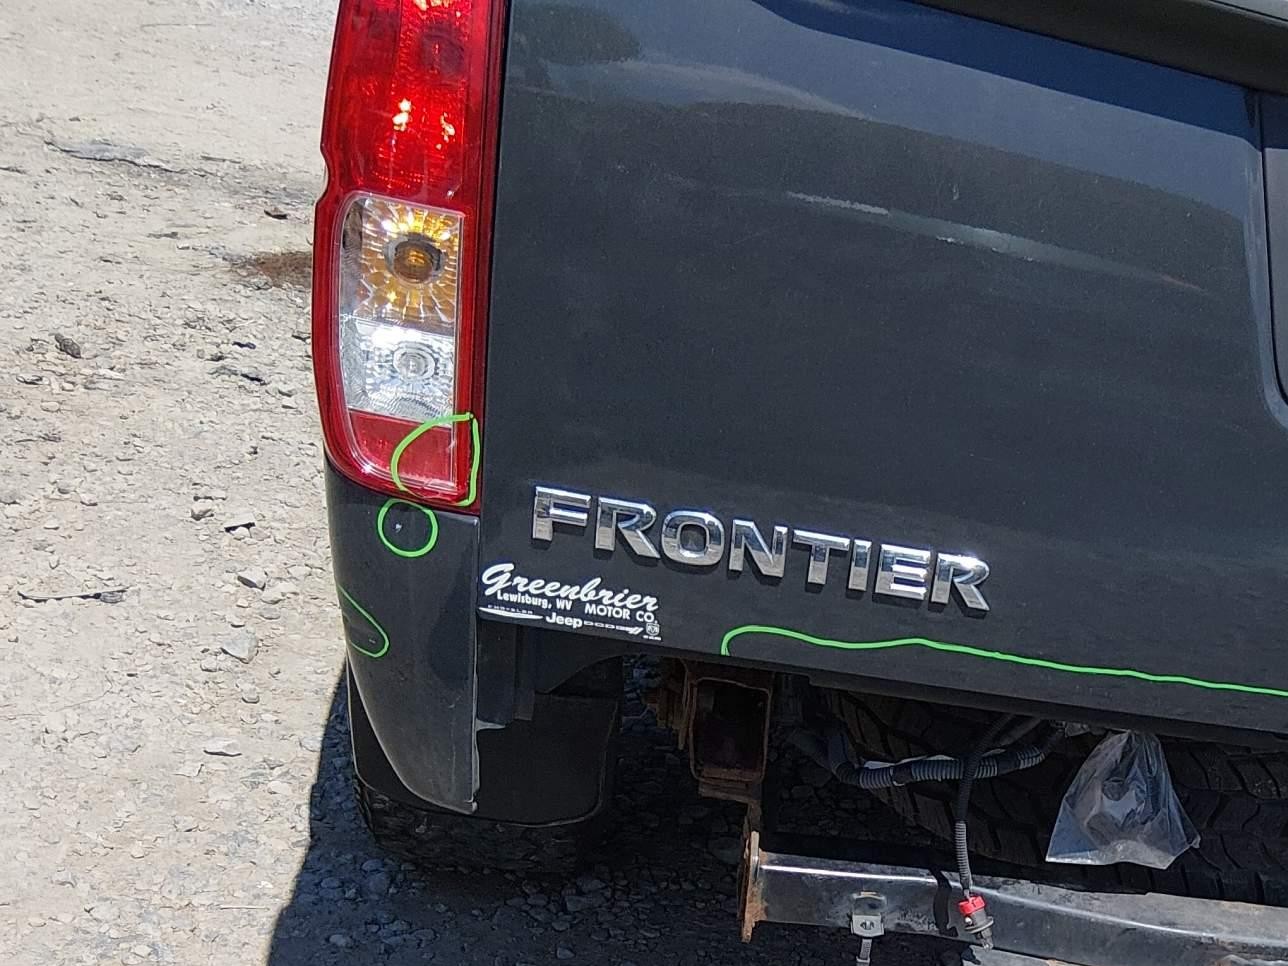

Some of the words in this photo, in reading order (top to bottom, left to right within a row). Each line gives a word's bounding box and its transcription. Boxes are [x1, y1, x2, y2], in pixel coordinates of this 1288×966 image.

[532, 485, 991, 612] FRONTIER
[481, 562, 659, 612] Greenbrier
[496, 590, 552, 610] Lewisburg,
[556, 598, 573, 611] WV
[545, 612, 583, 629] Jeep
[584, 603, 631, 620] MOTOR
[635, 610, 659, 625] CO.
